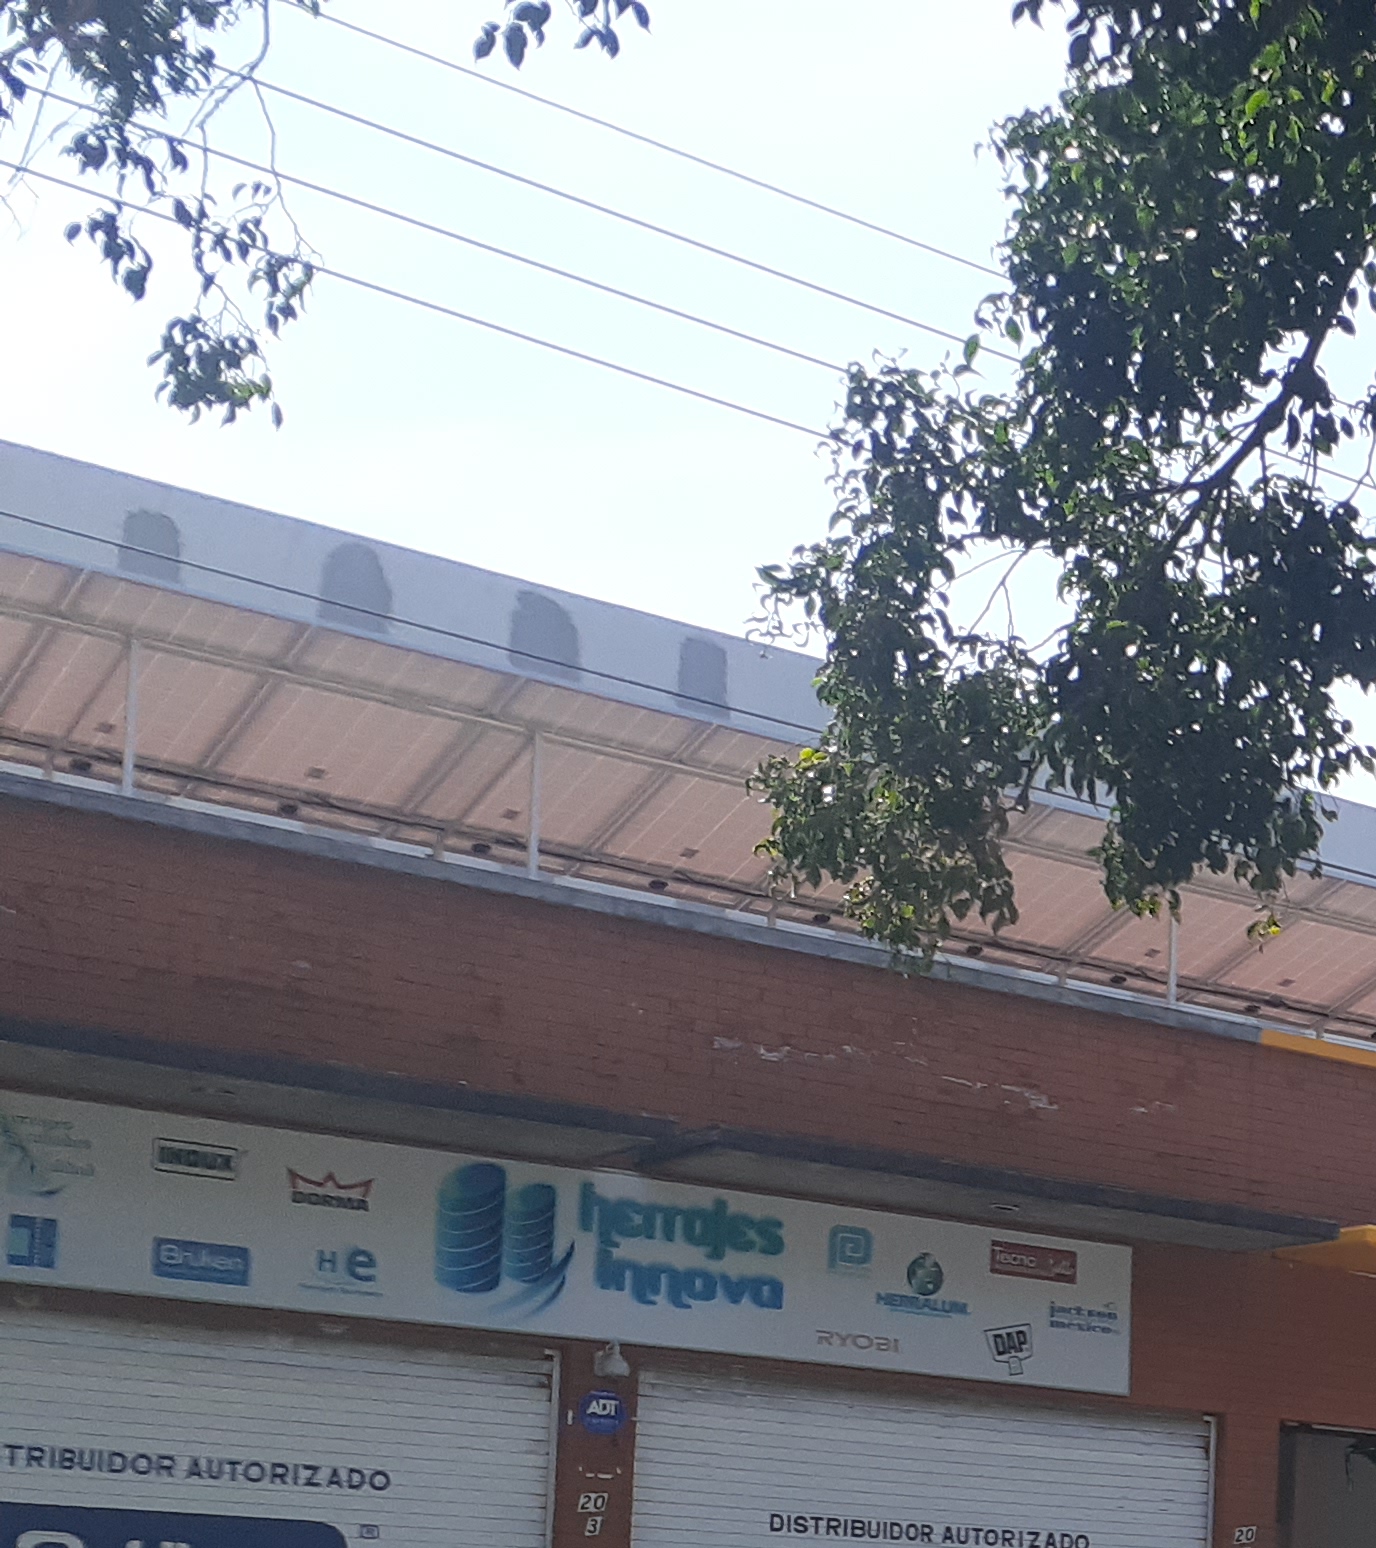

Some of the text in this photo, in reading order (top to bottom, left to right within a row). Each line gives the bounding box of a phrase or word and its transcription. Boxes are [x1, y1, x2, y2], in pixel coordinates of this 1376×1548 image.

[815, 1329, 900, 1353] RYOBI
[992, 1330, 1028, 1356] DAP
[585, 1400, 620, 1416] ADT
[185, 1456, 392, 1492] AUTORIZADO
[579, 1494, 606, 1511] 20
[586, 1517, 598, 1534] 3
[769, 1513, 935, 1543] DISTRIBUIDOR
[1235, 1528, 1255, 1543] 20
